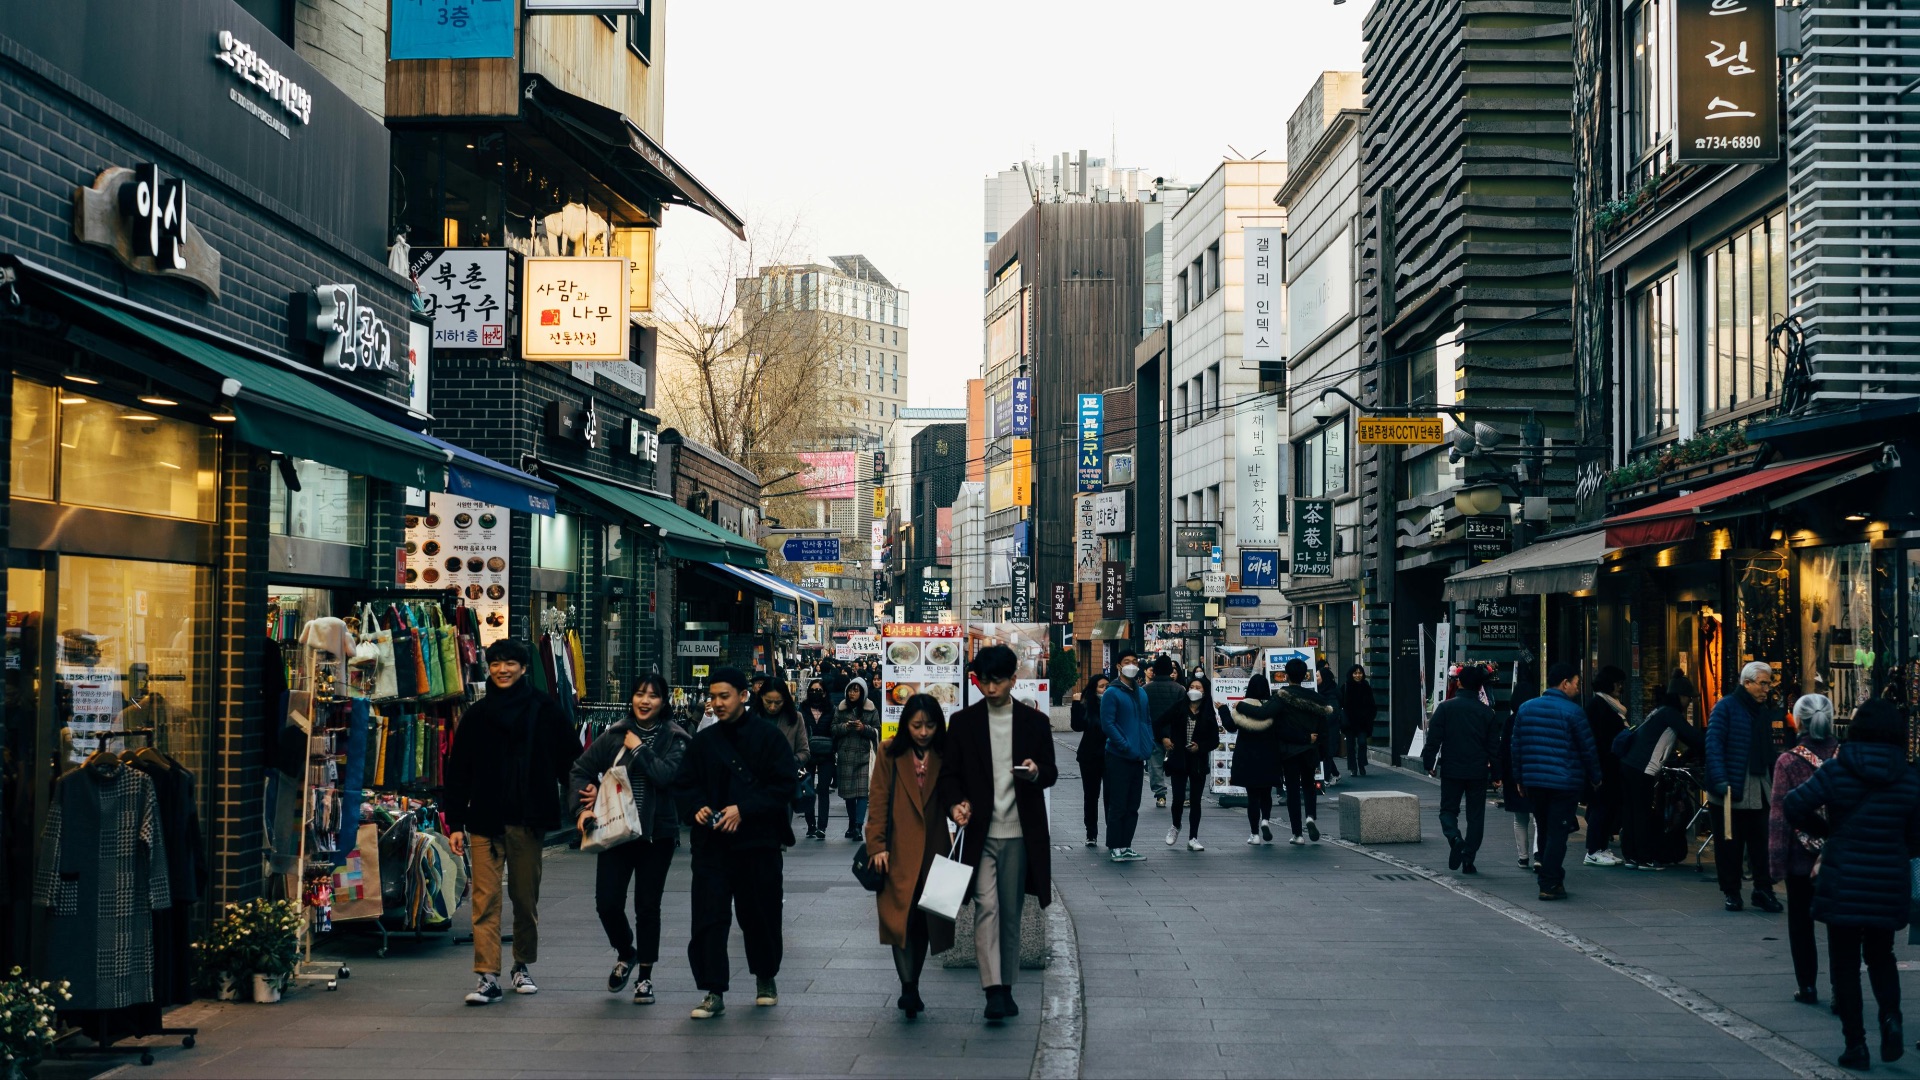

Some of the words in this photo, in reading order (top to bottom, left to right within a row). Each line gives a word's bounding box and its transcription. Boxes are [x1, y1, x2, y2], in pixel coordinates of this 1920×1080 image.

[437, 6, 469, 28] 3층
[1705, 136, 1761, 149] 734-6890
[137, 163, 187, 270] 아신
[1256, 237, 1269, 286] 갤러리
[431, 262, 487, 290] 북촌
[536, 280, 590, 302] 사람과
[423, 293, 499, 322] 칼국수
[572, 306, 612, 321] 나무
[435, 329, 478, 342] 지하1층
[1255, 300, 1269, 347] 인덱스
[549, 331, 597, 345] 전통찻집
[1015, 379, 1029, 426] 세종화랑
[1247, 463, 1267, 492] 반한
[1252, 498, 1267, 531] 찻집
[1081, 499, 1095, 568] 윤경표구사
[1296, 551, 1328, 562] 다암
[1015, 576, 1026, 606] 칼국수
[1106, 567, 1115, 611] 국제자수원
[1482, 624, 1516, 634] 신옛찻집
[679, 644, 693, 653] TAL
[695, 644, 719, 653] BANG
[893, 665, 914, 674] 칼국수
[1215, 685, 1240, 693] 47번가
